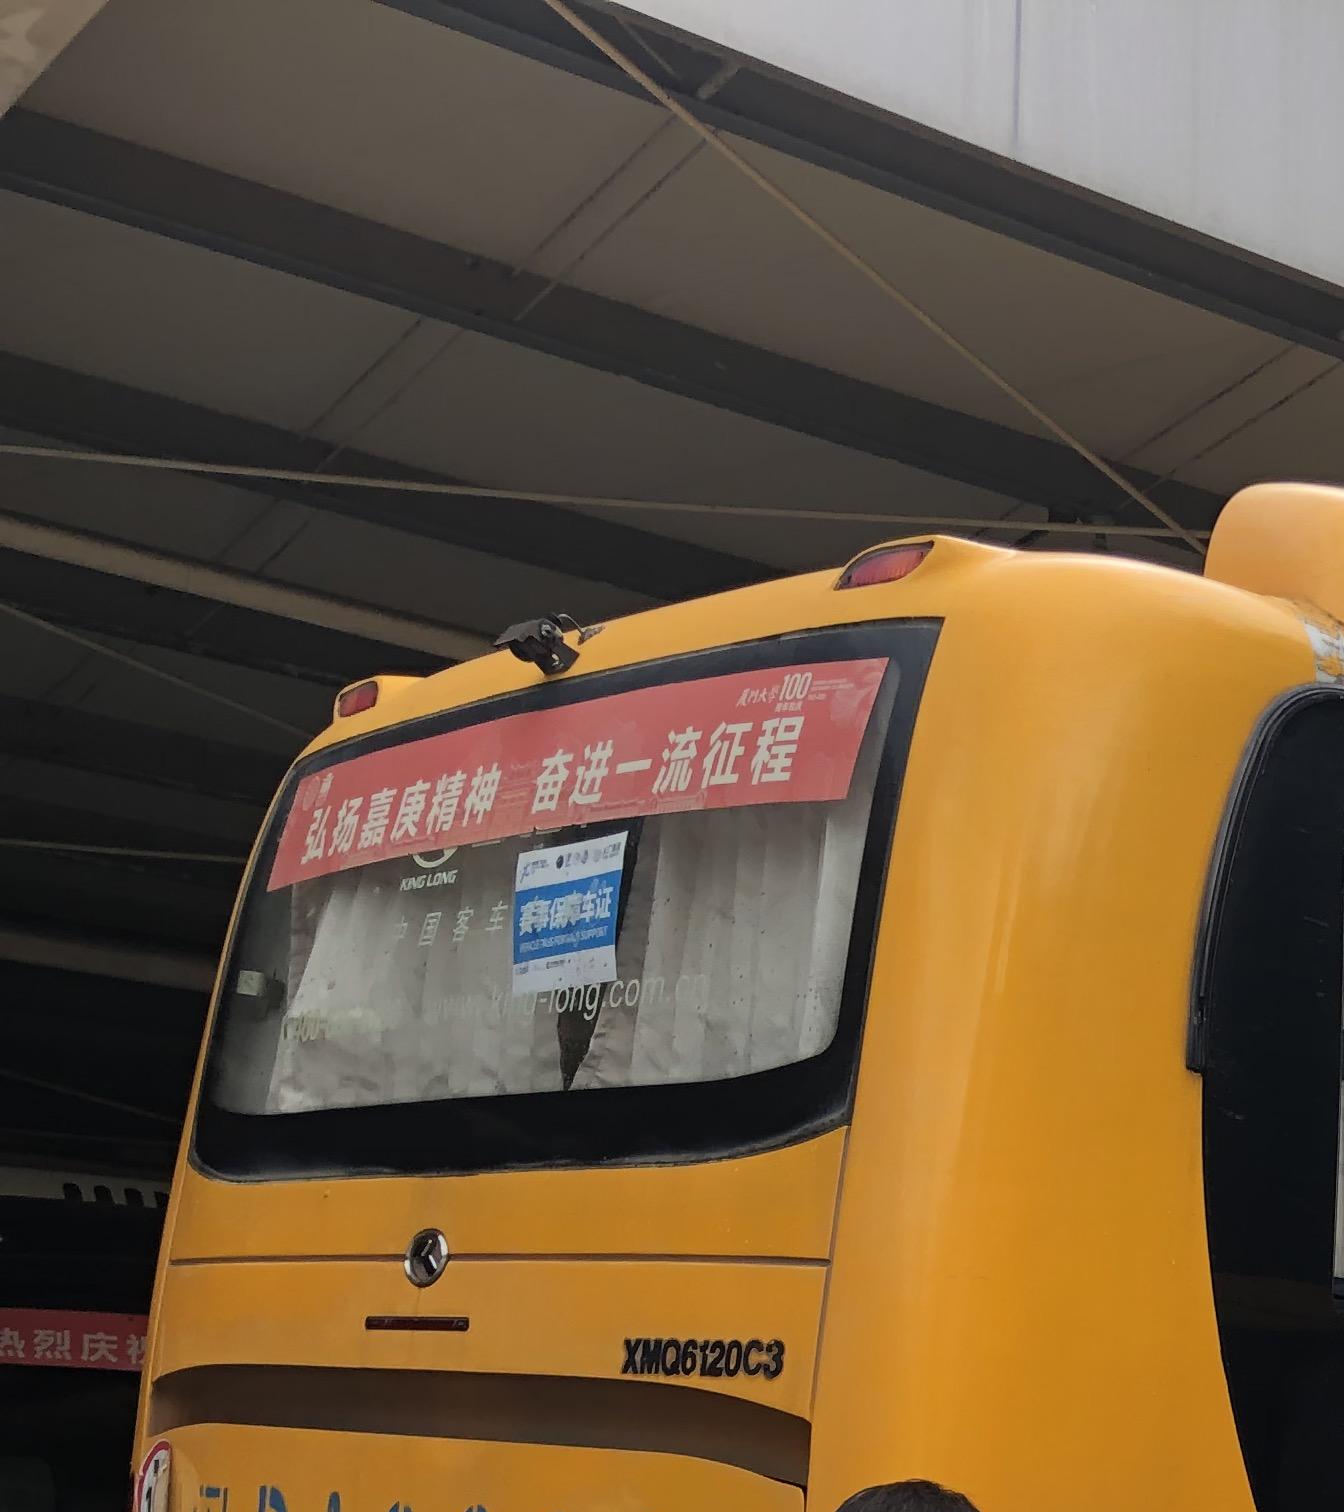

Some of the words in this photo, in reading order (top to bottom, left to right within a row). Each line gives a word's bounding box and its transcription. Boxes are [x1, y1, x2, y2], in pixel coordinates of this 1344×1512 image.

[780, 671, 813, 702] 100
[301, 765, 502, 865] 弘扬嘉庚精神
[531, 714, 806, 814] 奋进一流征程
[400, 876, 425, 891] KING
[427, 869, 459, 887] LONG
[621, 1337, 785, 1379] XMQ6120C3
